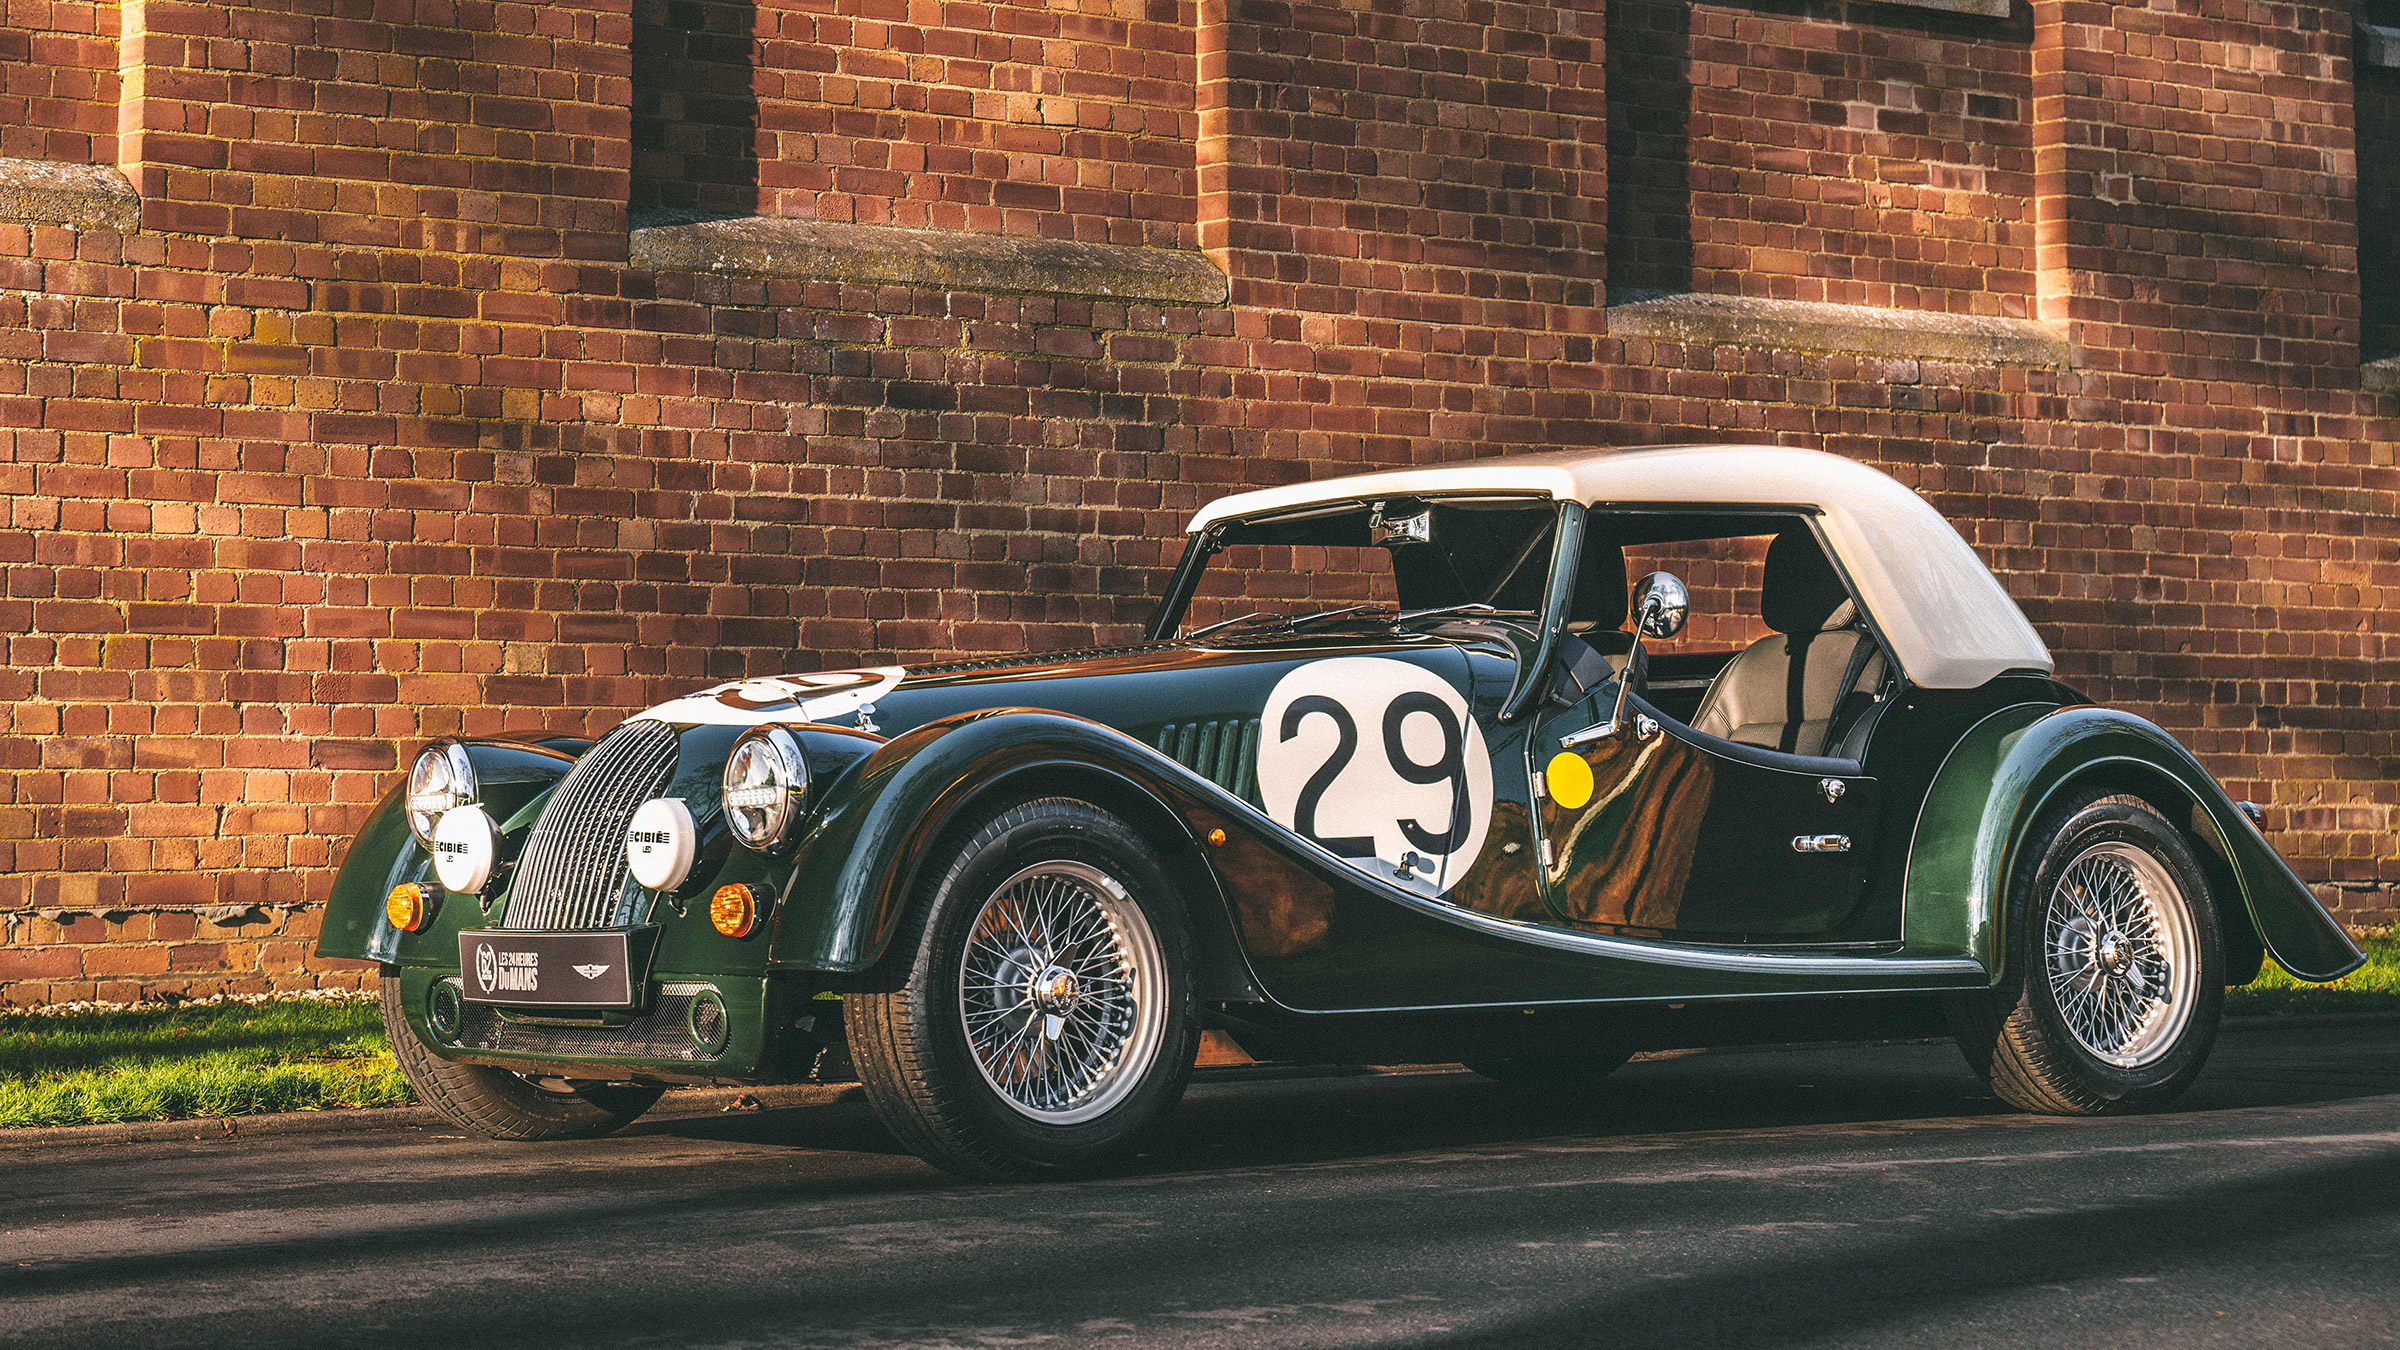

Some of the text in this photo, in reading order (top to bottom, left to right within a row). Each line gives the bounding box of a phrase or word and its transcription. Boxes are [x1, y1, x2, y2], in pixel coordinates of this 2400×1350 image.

[1279, 690, 1472, 858] 29
[642, 845, 652, 854] LED
[481, 951, 492, 975] 62
[498, 951, 539, 967] LES 24 HEURES
